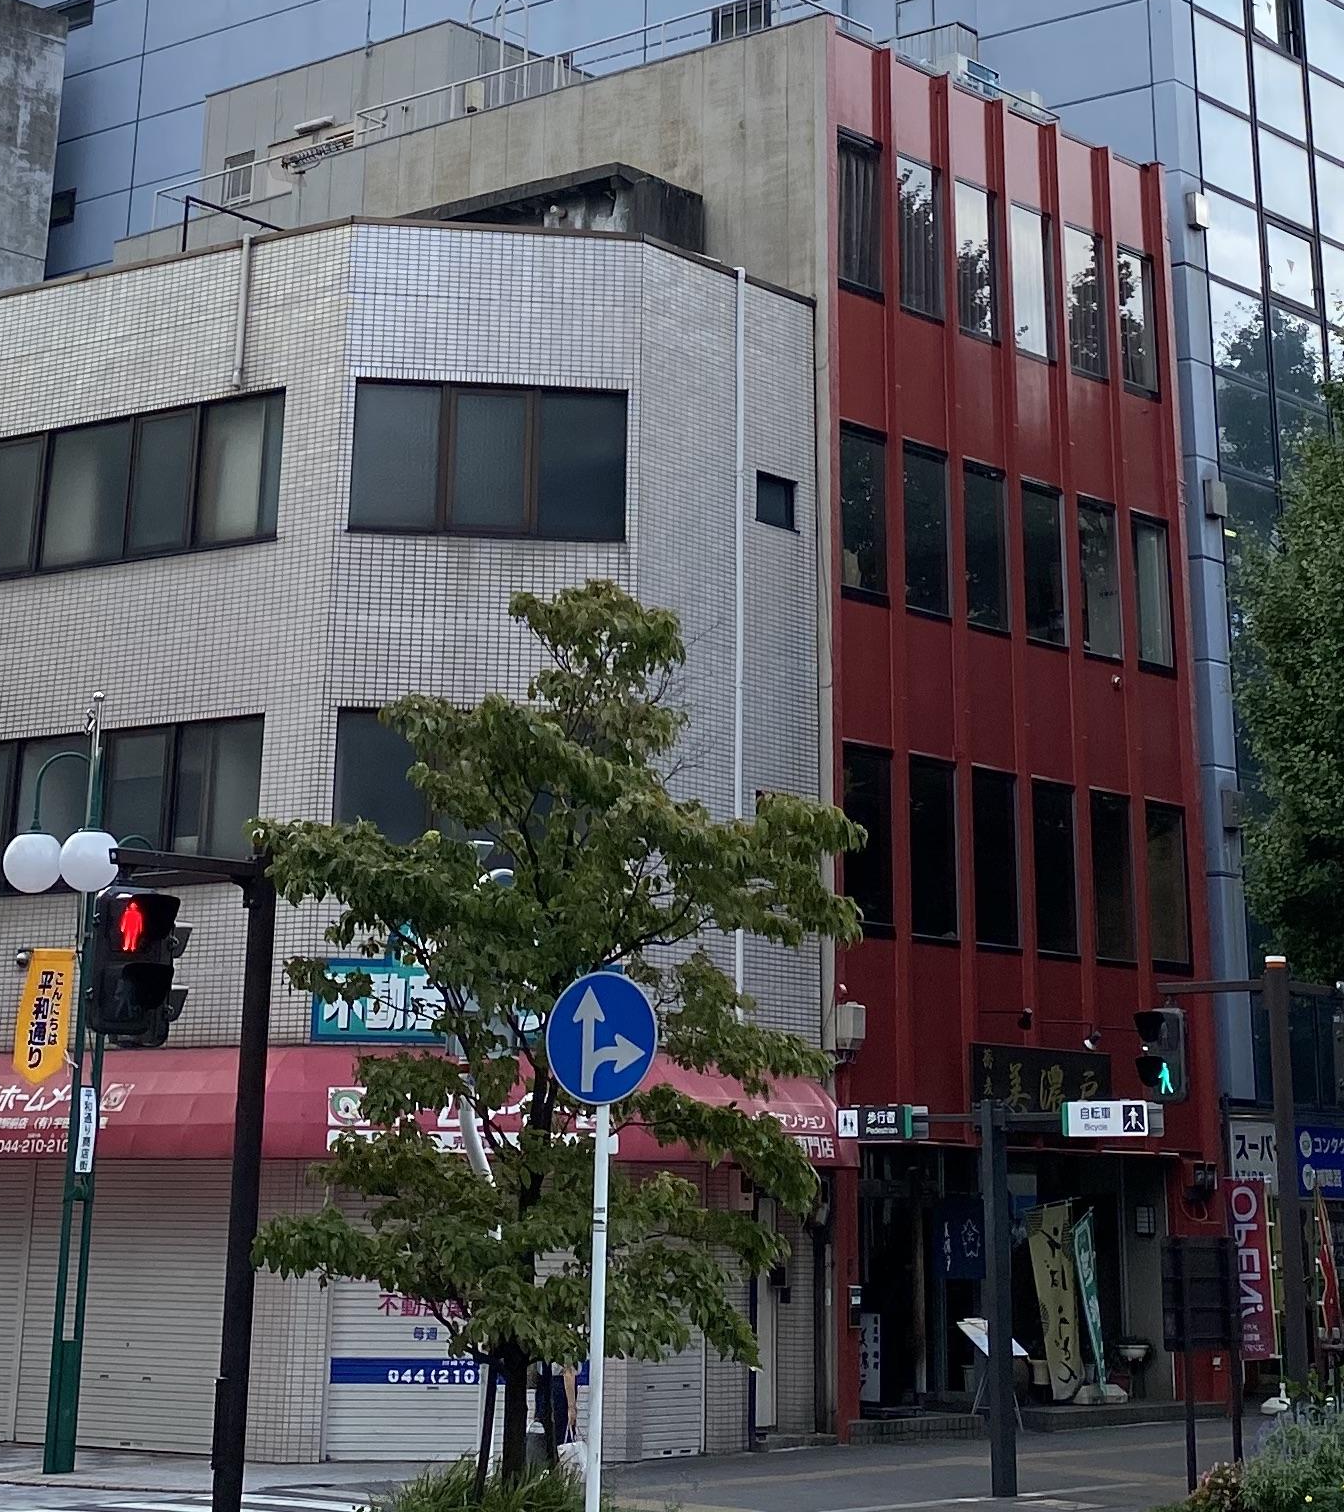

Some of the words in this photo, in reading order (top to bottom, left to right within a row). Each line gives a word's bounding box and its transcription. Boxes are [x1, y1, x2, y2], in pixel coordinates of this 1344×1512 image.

[27, 970, 55, 1069] 平和通り
[47, 971, 65, 1046] こんにちは
[78, 1089, 94, 1172] 平和通り商店街
[866, 1110, 897, 1126] 歩行者
